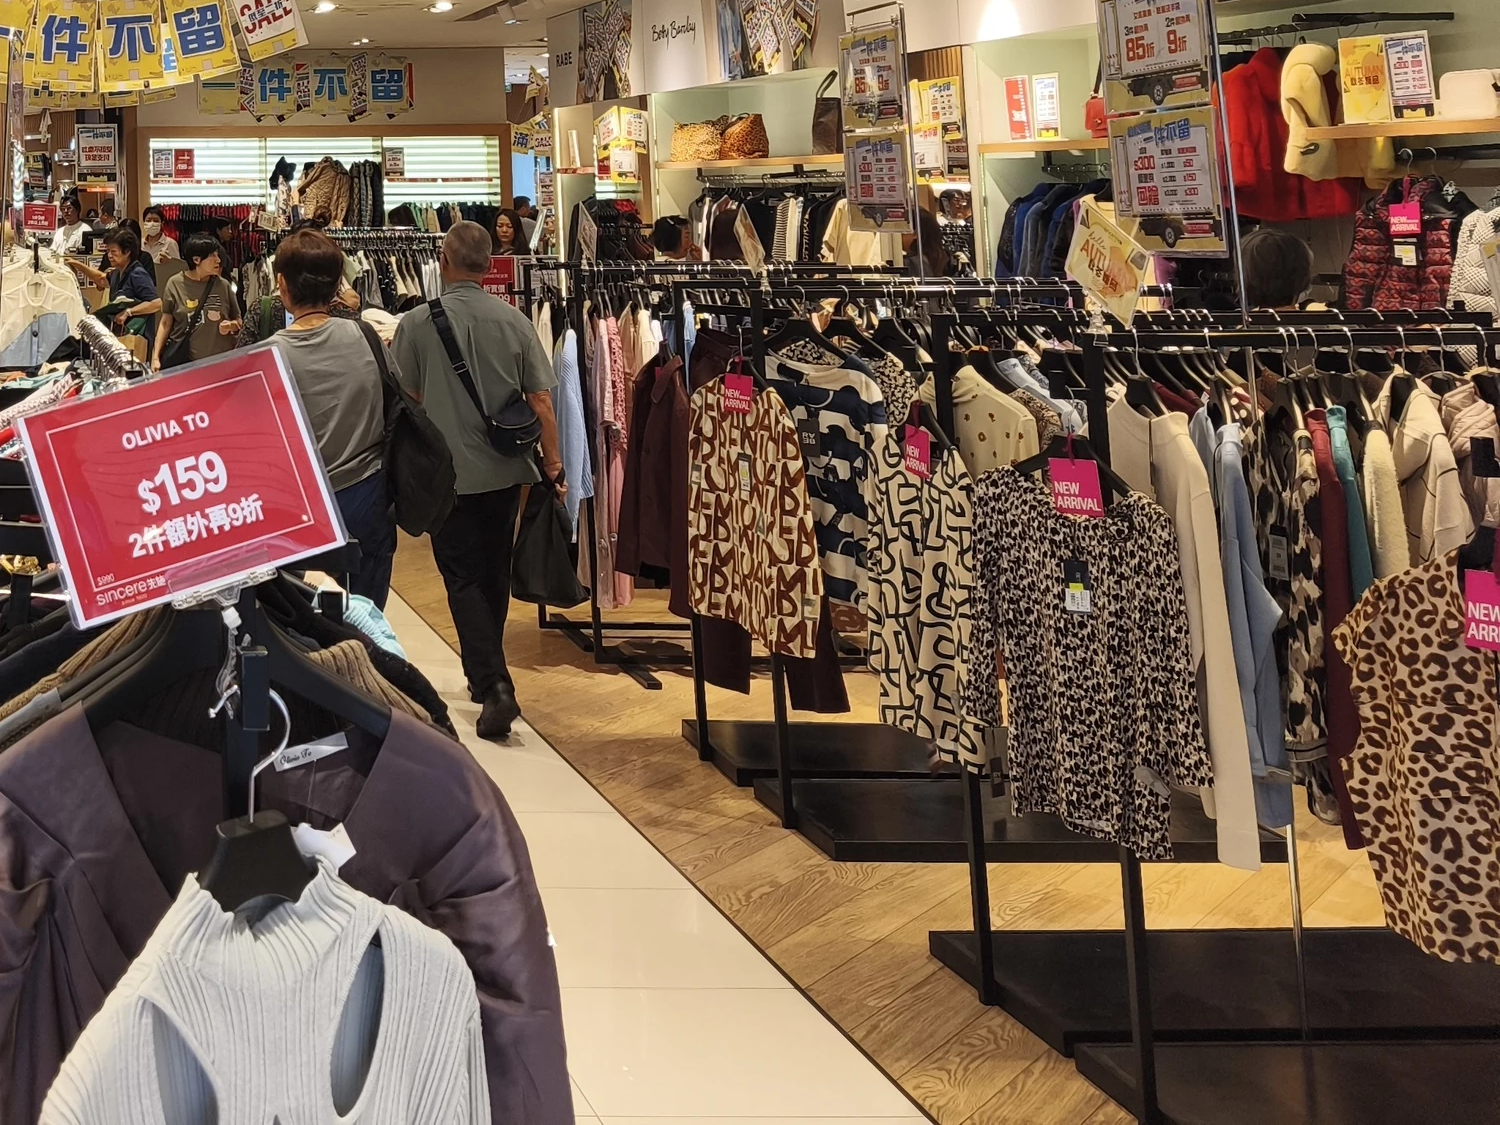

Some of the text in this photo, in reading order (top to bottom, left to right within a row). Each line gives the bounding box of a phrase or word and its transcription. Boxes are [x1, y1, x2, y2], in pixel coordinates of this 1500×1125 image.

[1125, 29, 1188, 62] 85折 9折
[556, 52, 573, 67] RABE
[202, 68, 404, 103] 一件不留
[1143, 117, 1190, 148] 一件不留
[1390, 216, 1408, 224] NEW
[1390, 224, 1420, 232] ARRIVAL
[725, 388, 740, 398] NEW
[725, 399, 751, 411] ARRIVAL
[122, 411, 210, 450] OLIVIA TO
[905, 444, 920, 457] NEW
[905, 459, 930, 475] ARRIVAL
[137, 450, 228, 515] $159
[1054, 480, 1080, 495] NEW
[1056, 495, 1102, 512] ARRIVAL
[128, 493, 265, 559] 2件額外再9折
[96, 580, 148, 606] sincere
[1467, 601, 1500, 623] NEW
